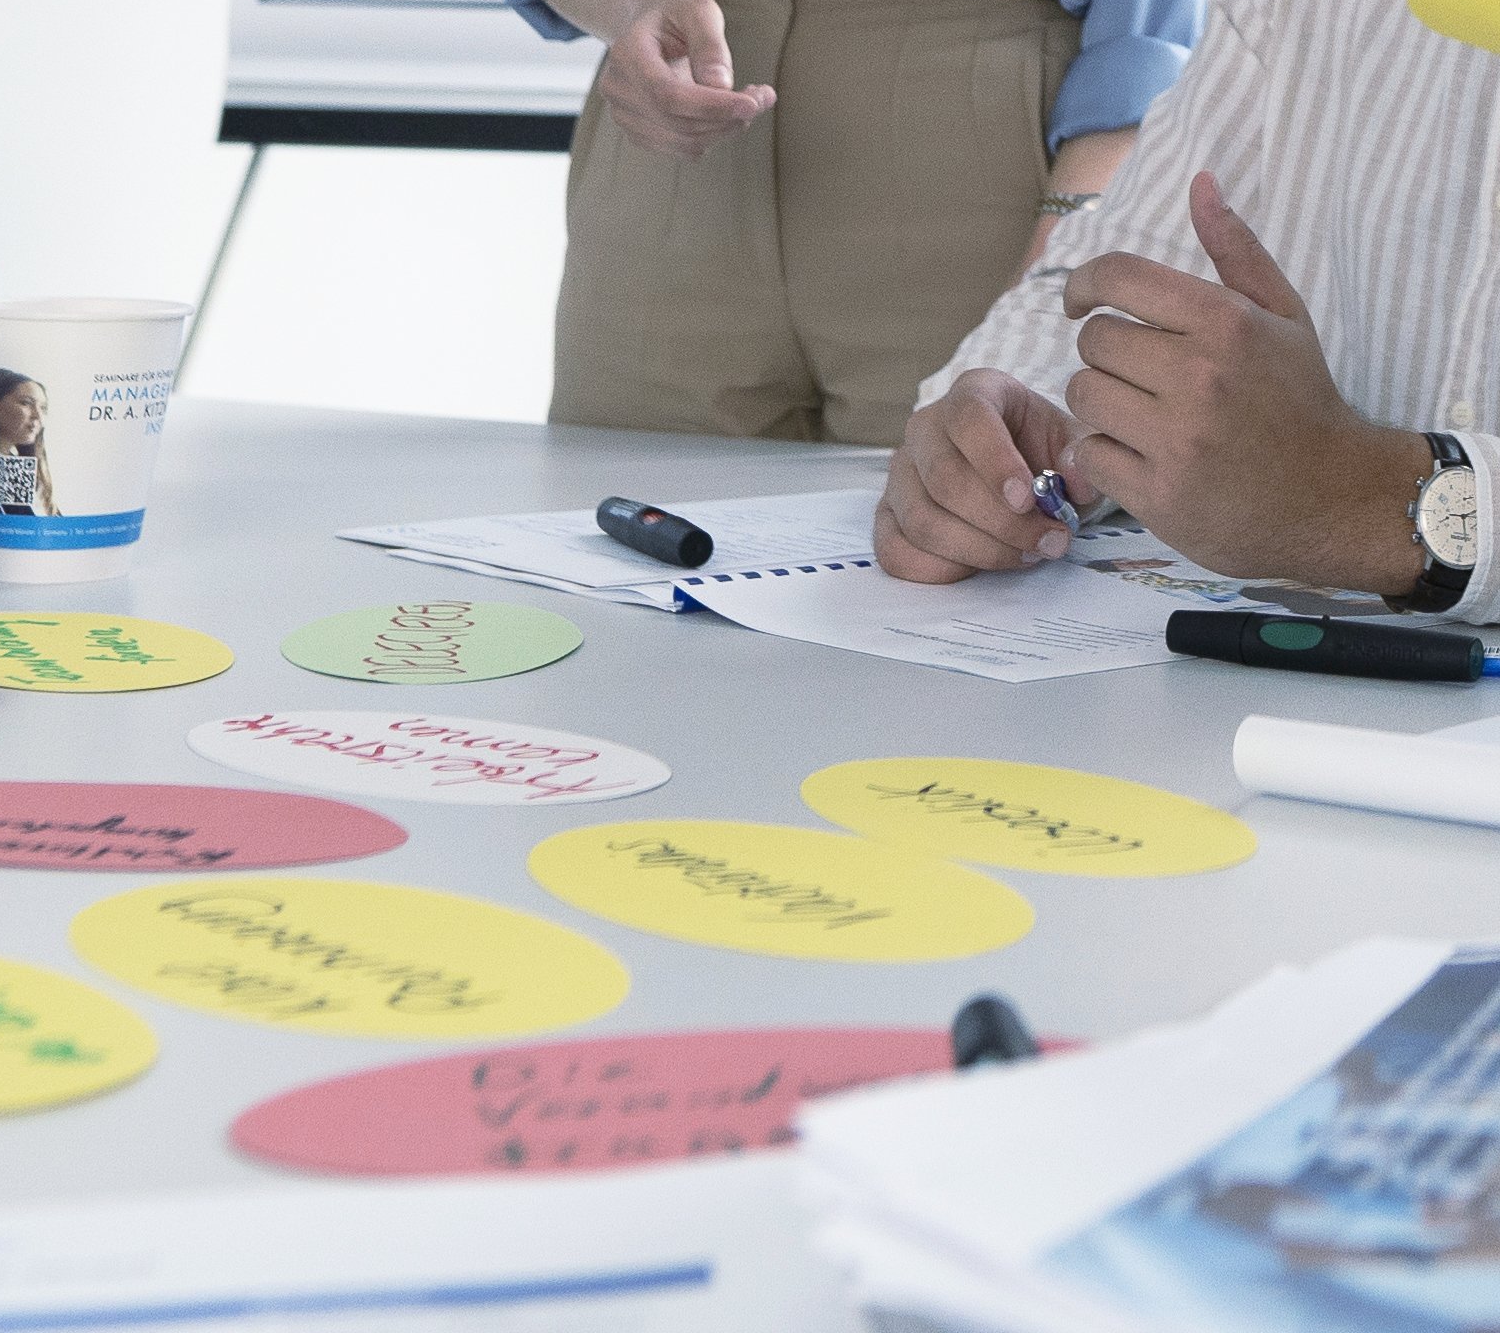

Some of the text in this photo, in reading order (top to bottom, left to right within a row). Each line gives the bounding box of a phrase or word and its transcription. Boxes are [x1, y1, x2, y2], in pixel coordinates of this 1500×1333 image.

[93, 372, 140, 384] SEMINARE
[89, 405, 117, 422] DR.
[123, 404, 139, 420] A.
